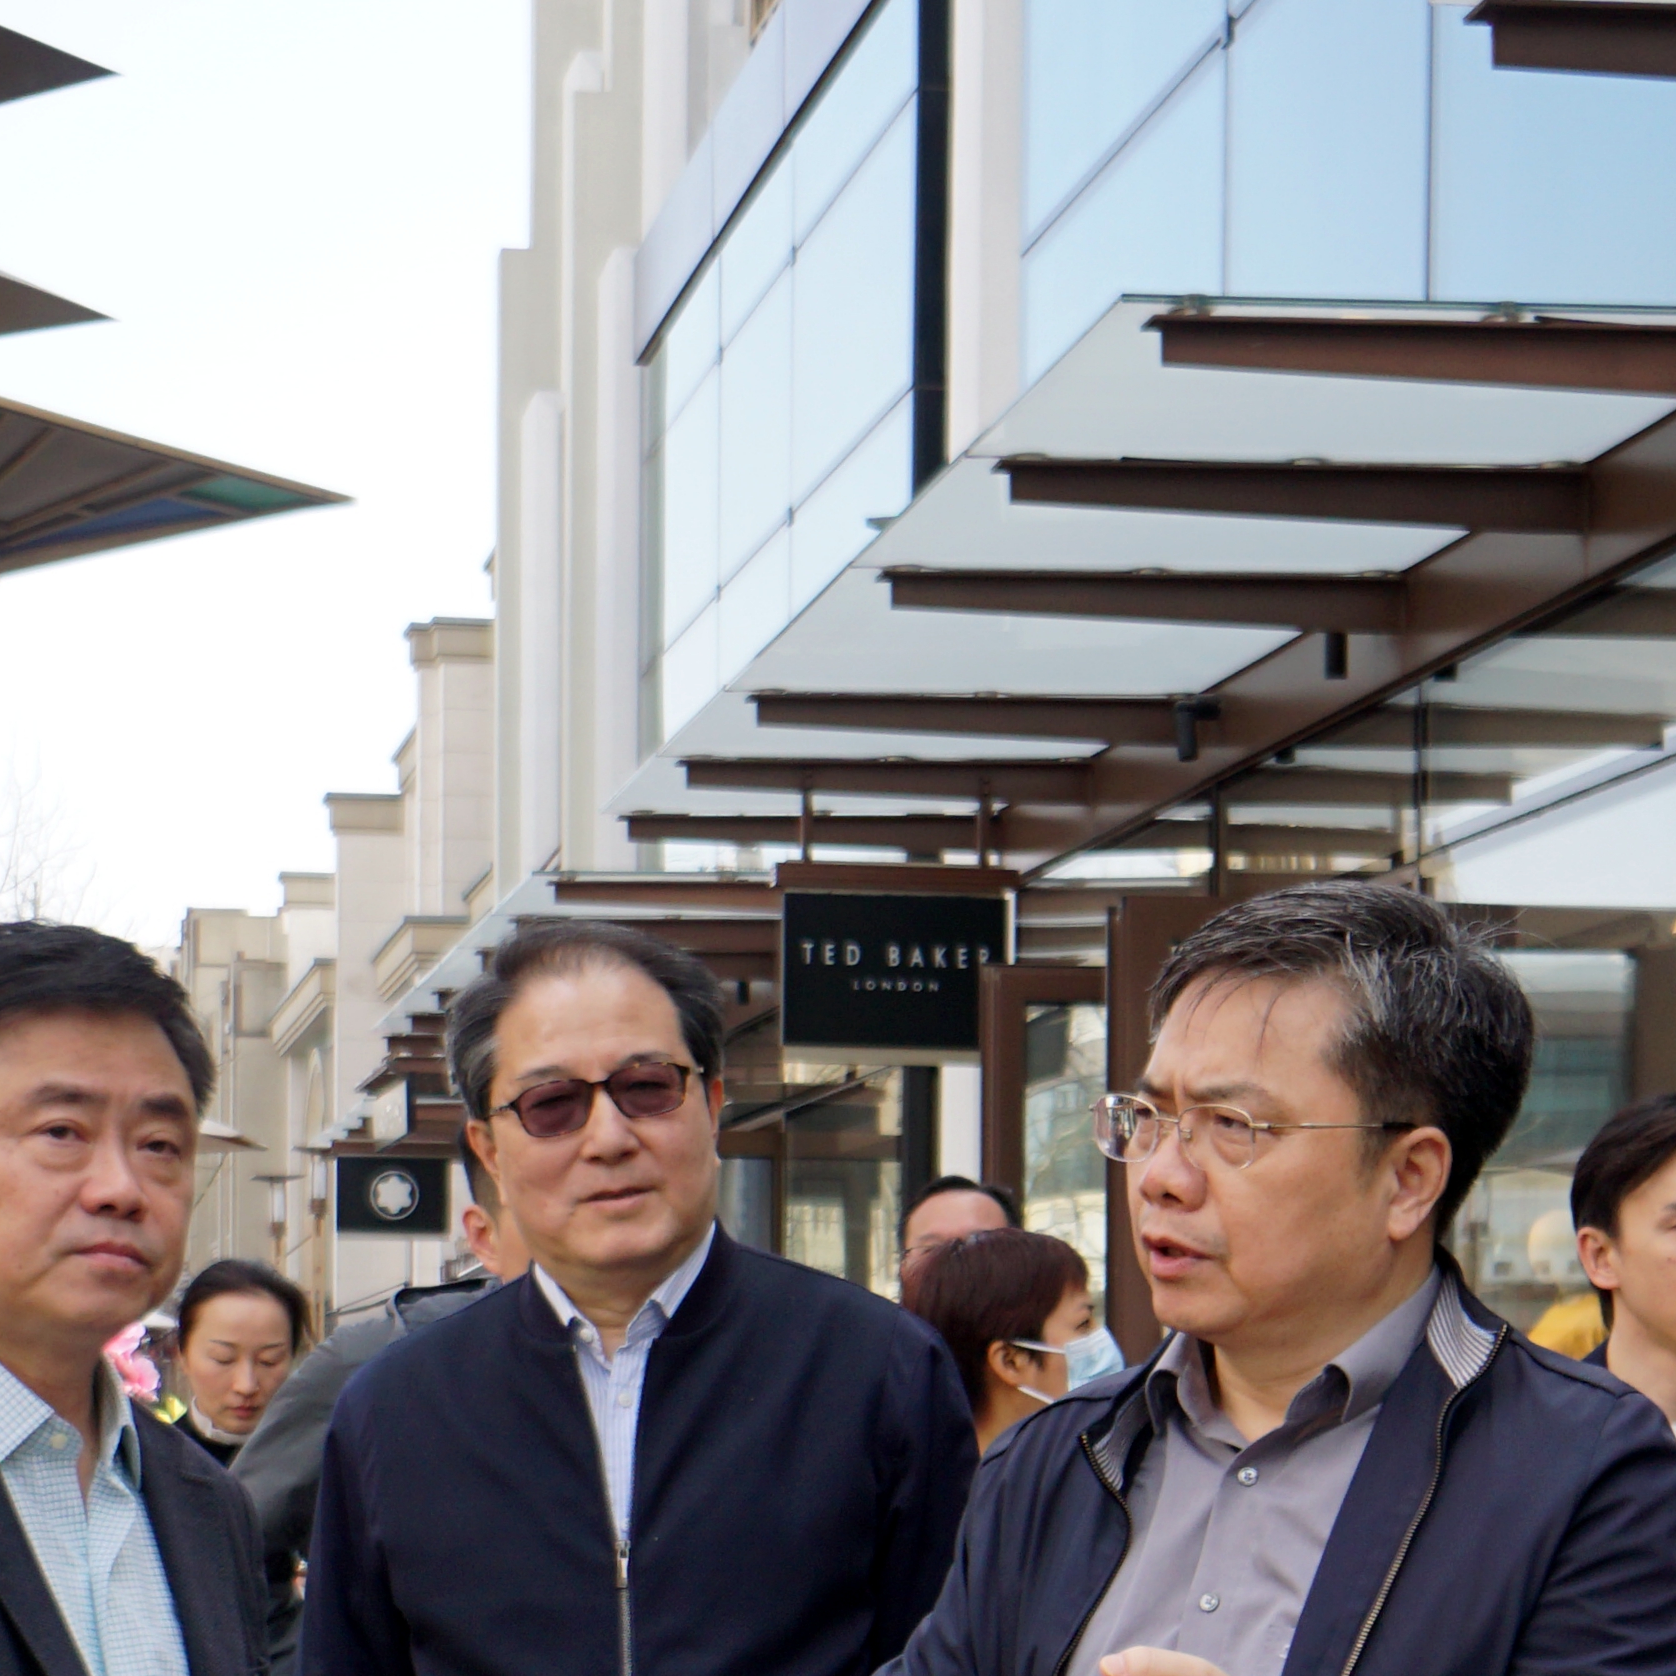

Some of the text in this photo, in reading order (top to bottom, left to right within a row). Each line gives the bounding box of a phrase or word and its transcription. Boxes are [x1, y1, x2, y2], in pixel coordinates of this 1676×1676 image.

[801, 942, 990, 969] TED BAKER
[853, 979, 940, 992] LONDON
